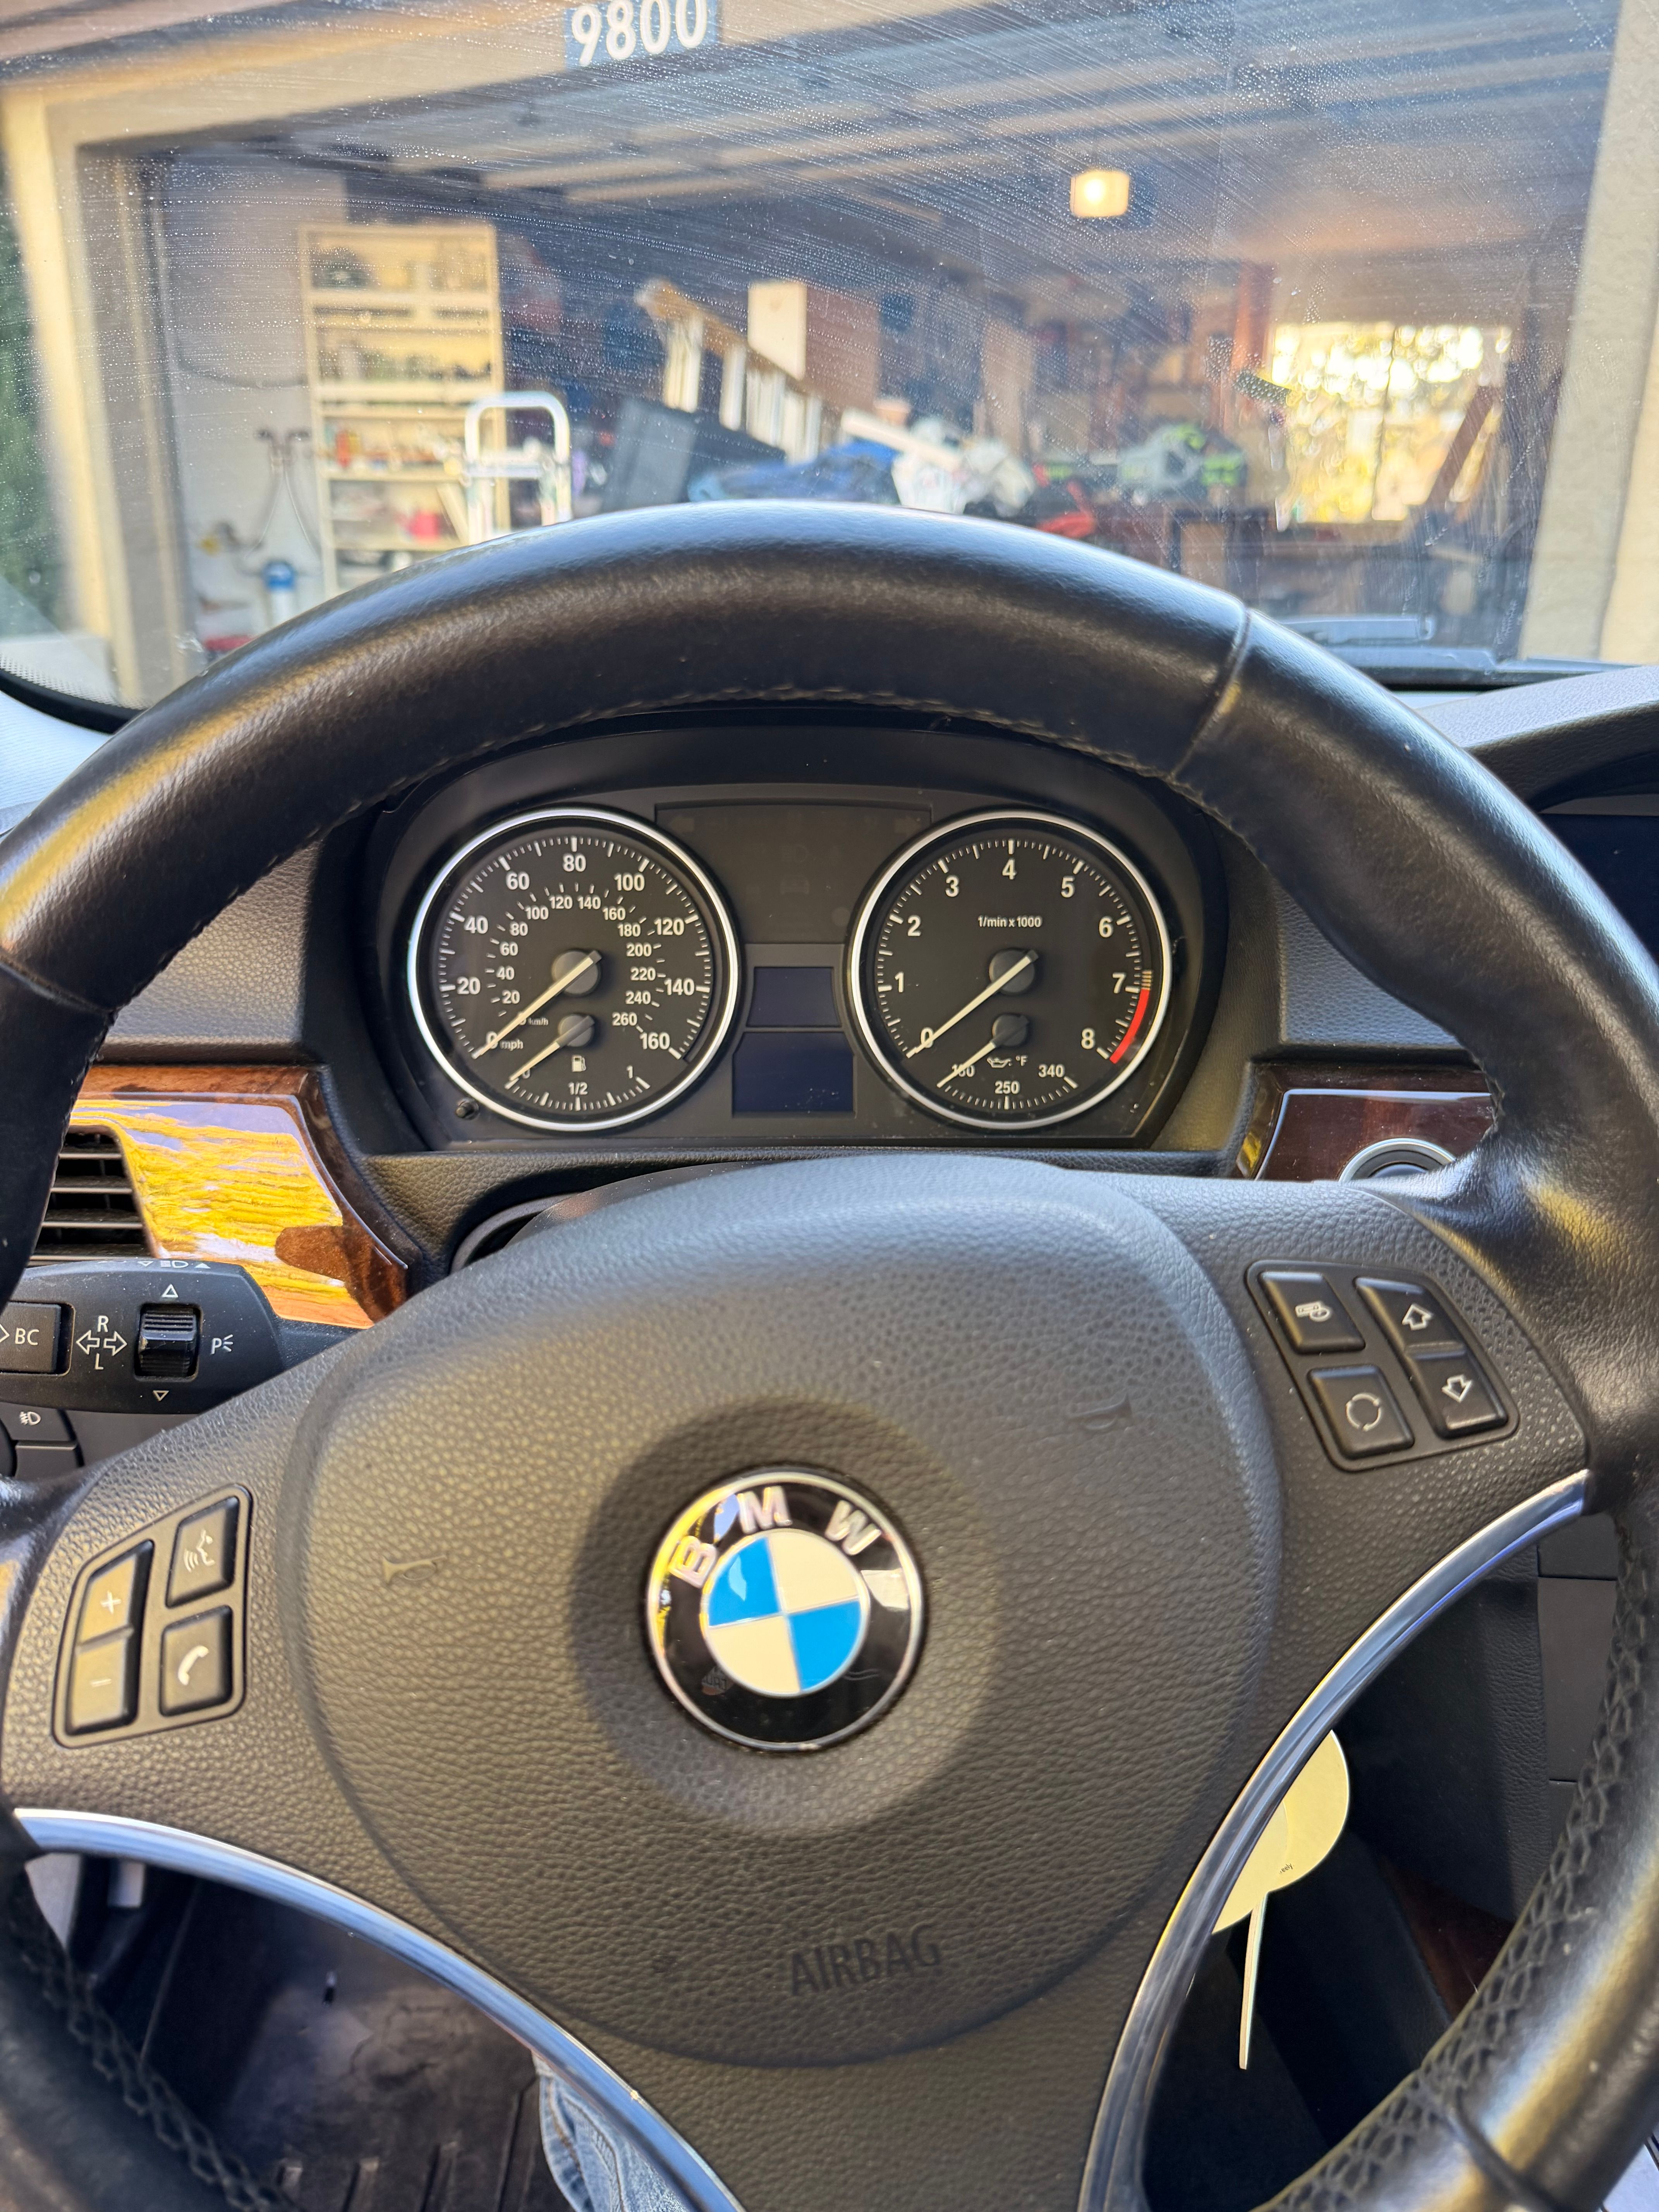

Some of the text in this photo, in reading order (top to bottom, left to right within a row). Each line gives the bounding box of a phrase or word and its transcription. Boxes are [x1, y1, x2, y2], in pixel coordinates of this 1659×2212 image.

[572, 0, 707, 66] 9800
[563, 854, 586, 871] 80
[1003, 859, 1016, 879] 4
[506, 872, 529, 890] 60
[615, 874, 644, 891] 100
[946, 876, 959, 897] 3
[1061, 876, 1074, 897] 5
[549, 896, 572, 909] 120
[578, 896, 601, 909] 140
[525, 906, 548, 919] 100
[603, 907, 625, 920] 160
[464, 916, 488, 934] 40
[510, 923, 528, 936] 80
[618, 923, 641, 936] 180
[654, 918, 685, 935] 120
[908, 915, 921, 936] 2
[978, 916, 1041, 927] 1/min x 1000
[1099, 917, 1113, 937] 6
[500, 942, 518, 955] 60
[627, 943, 651, 957] 200
[496, 966, 514, 980] 40
[631, 967, 656, 981] 220
[458, 977, 480, 994] 20
[665, 978, 694, 995] 140
[895, 972, 903, 992] 1
[1113, 973, 1125, 993] 7
[503, 991, 520, 1004] 20
[626, 991, 651, 1004] 240
[612, 1013, 638, 1026] 260
[500, 1039, 523, 1051] mph
[640, 1033, 670, 1050] 160
[1082, 1028, 1095, 1049] 8
[627, 1066, 632, 1078] 1
[1039, 1065, 1065, 1077] 340
[569, 1082, 587, 1094] 1/2
[995, 1081, 1020, 1094] 250
[98, 1316, 108, 1332] R
[15, 1328, 39, 1345] BC
[211, 1338, 222, 1354] P
[95, 1353, 103, 1369] L
[668, 1486, 881, 1588] BMW
[792, 1923, 940, 1995] AIRBAG
